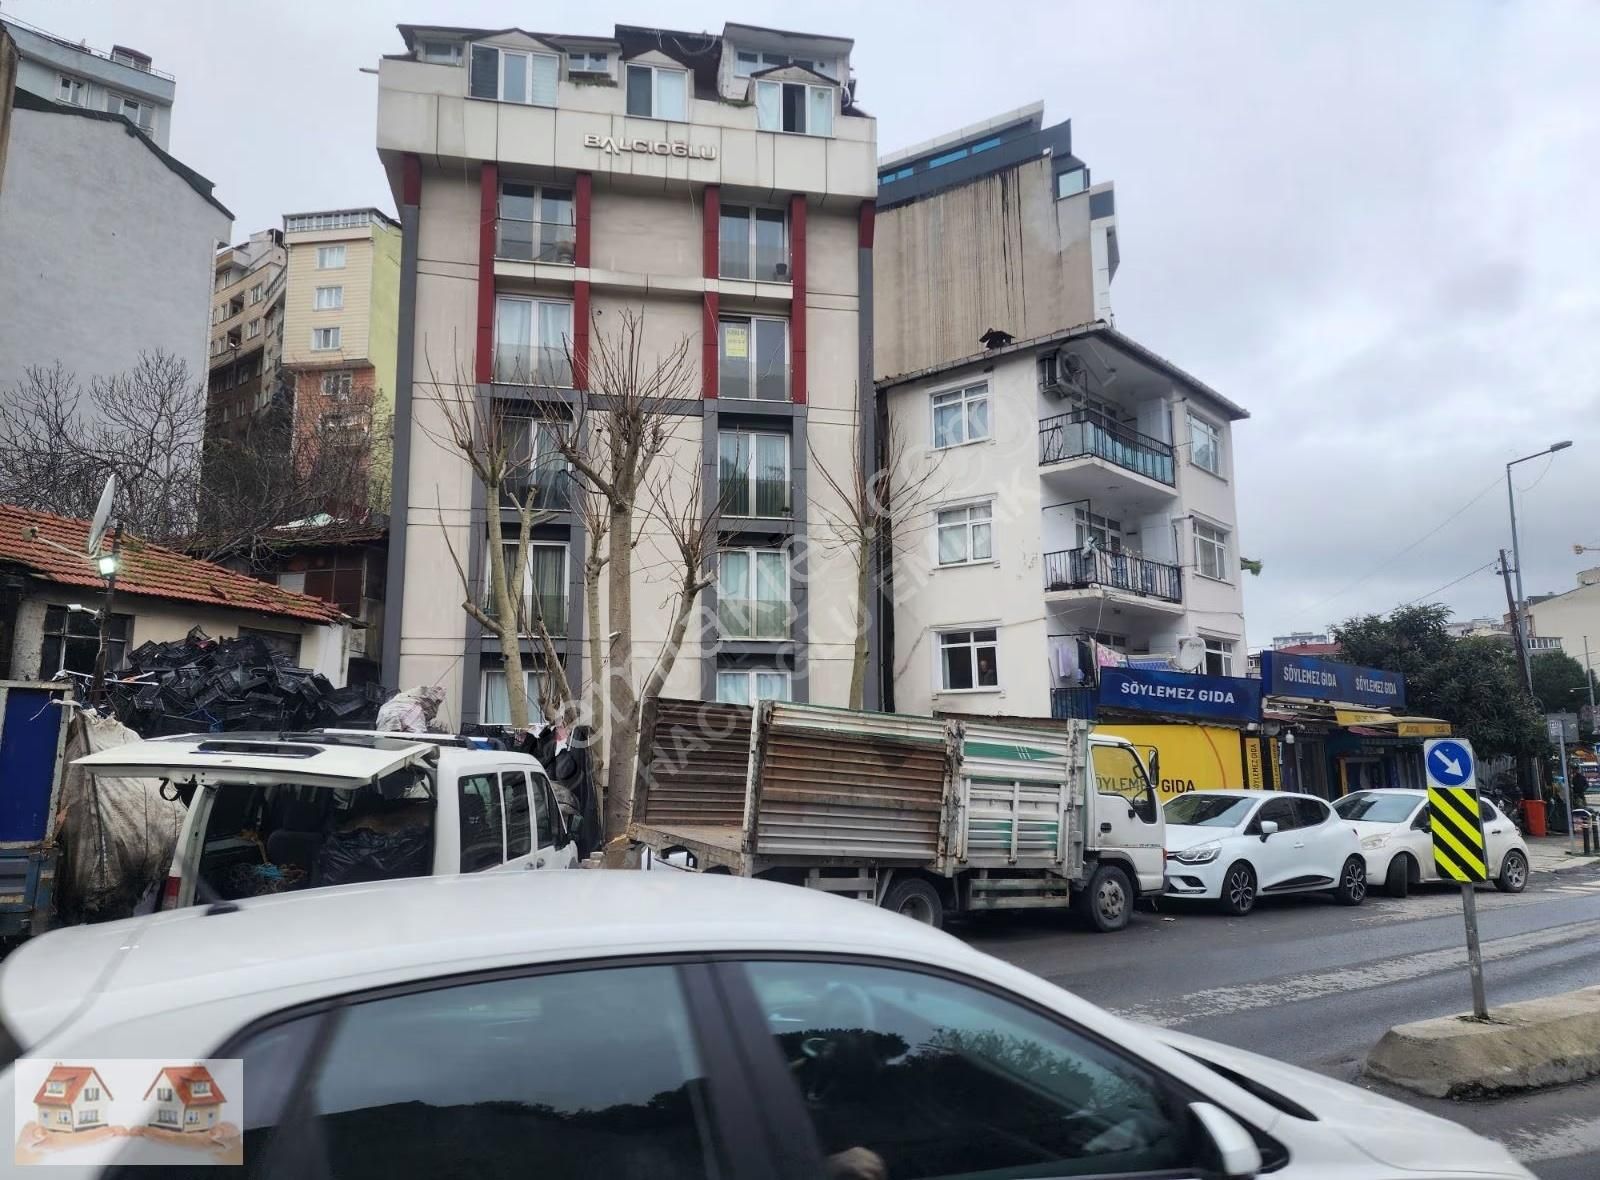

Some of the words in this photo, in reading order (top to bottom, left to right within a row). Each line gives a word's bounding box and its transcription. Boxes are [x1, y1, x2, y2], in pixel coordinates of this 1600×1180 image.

[1283, 663, 1321, 684] SÖYLEMEZ
[1120, 681, 1194, 700] SÖYLEMEZ
[1198, 690, 1235, 703] GIDA
[1355, 675, 1384, 693] SÖYLEMEZ
[1161, 779, 1196, 793] GIDA
